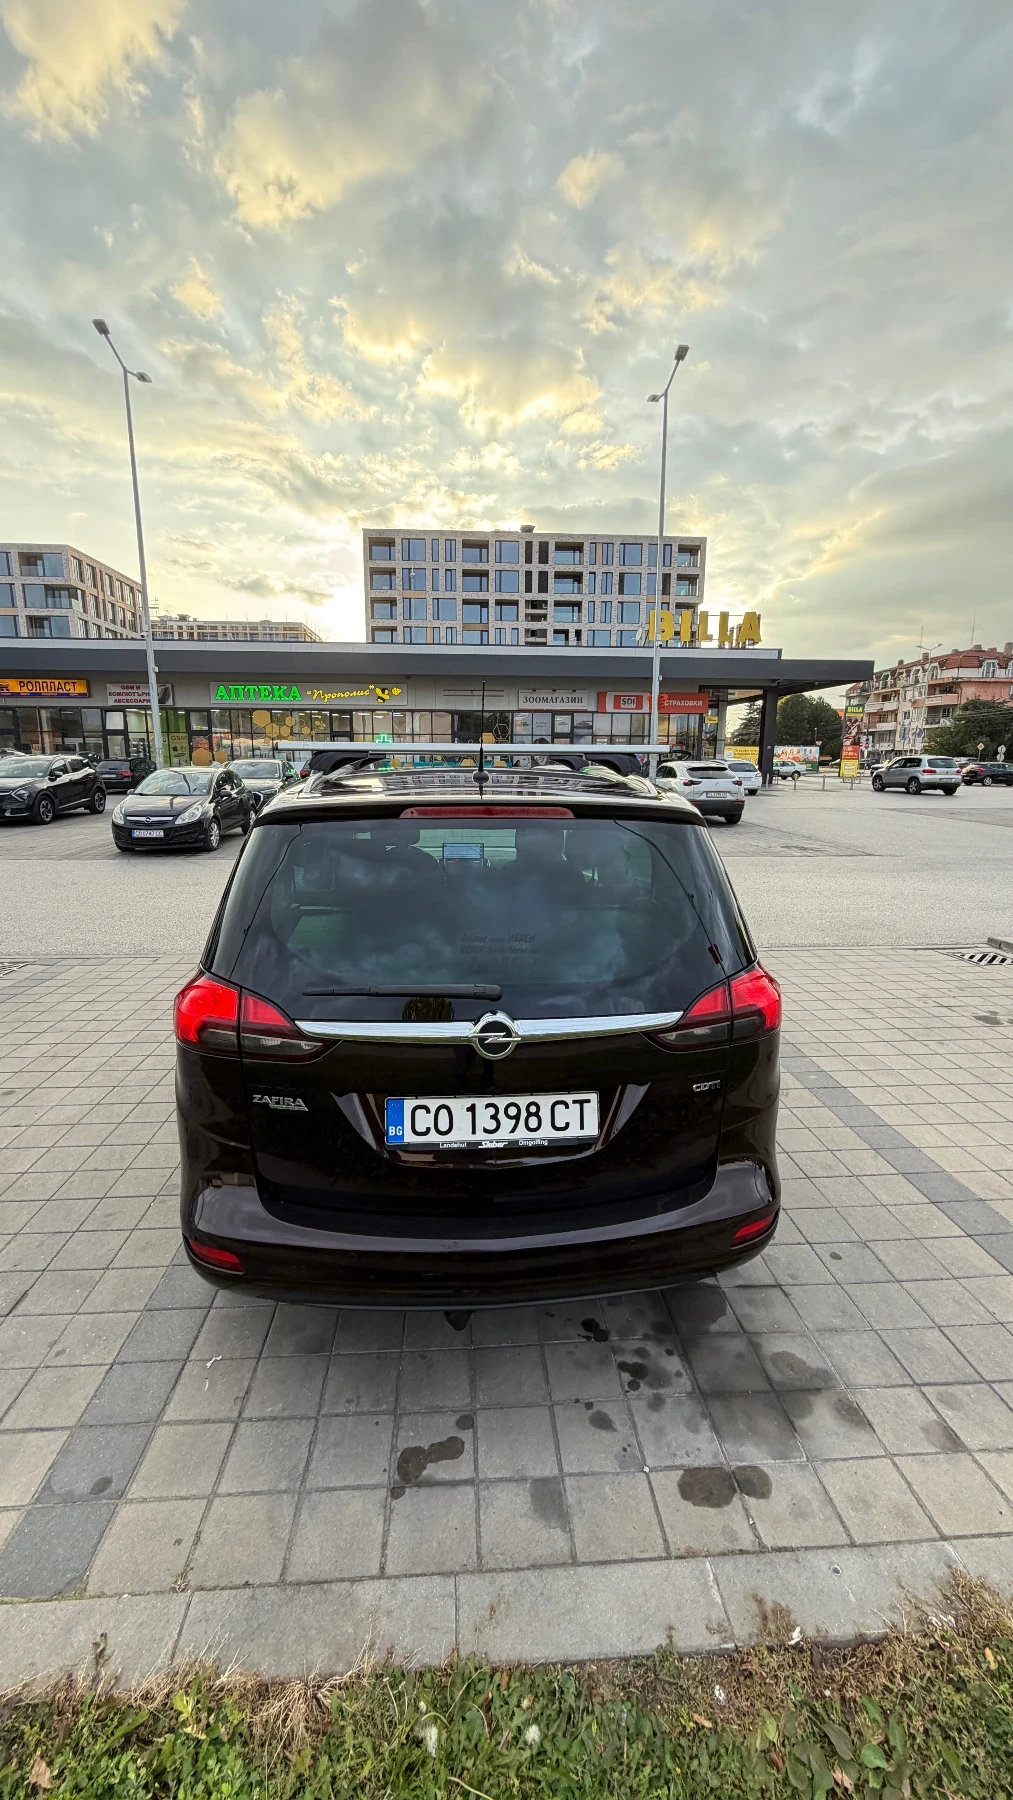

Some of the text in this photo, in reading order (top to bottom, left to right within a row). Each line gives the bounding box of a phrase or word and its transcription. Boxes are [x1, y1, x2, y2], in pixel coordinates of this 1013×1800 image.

[648, 609, 762, 643] BILLA
[18, 681, 77, 692] РОЛПЛАСТ
[215, 685, 303, 701] АПТЕКА
[522, 695, 583, 704] ЗООМАГАЗИН
[252, 1094, 306, 1106] ZAFIRA
[410, 1103, 454, 1137] CO
[388, 1126, 403, 1137] BG
